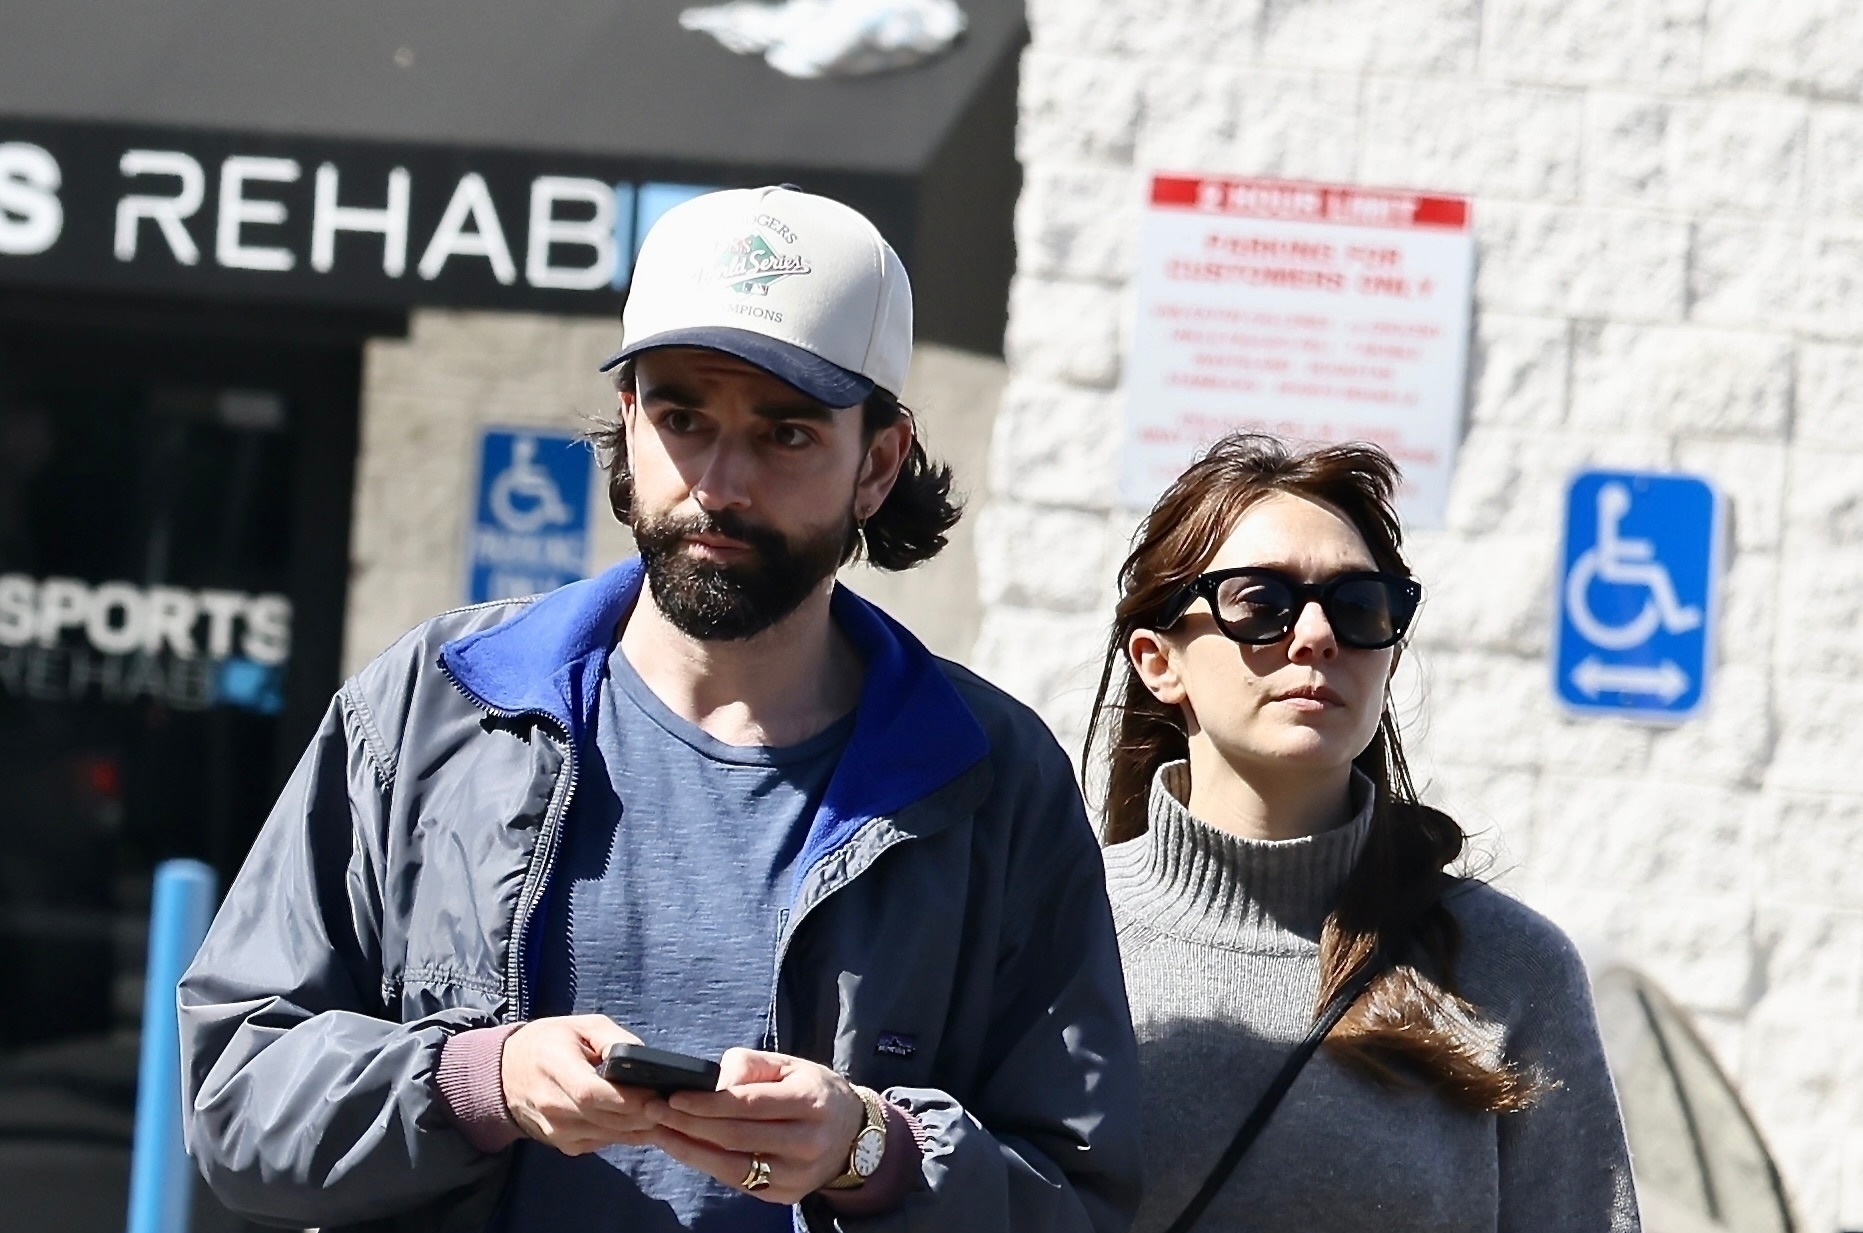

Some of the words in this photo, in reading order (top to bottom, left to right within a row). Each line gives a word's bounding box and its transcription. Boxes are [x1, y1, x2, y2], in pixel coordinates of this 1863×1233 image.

[114, 149, 618, 291] REHAB
[748, 250, 811, 274] Series
[0, 572, 293, 666] SPORTS
